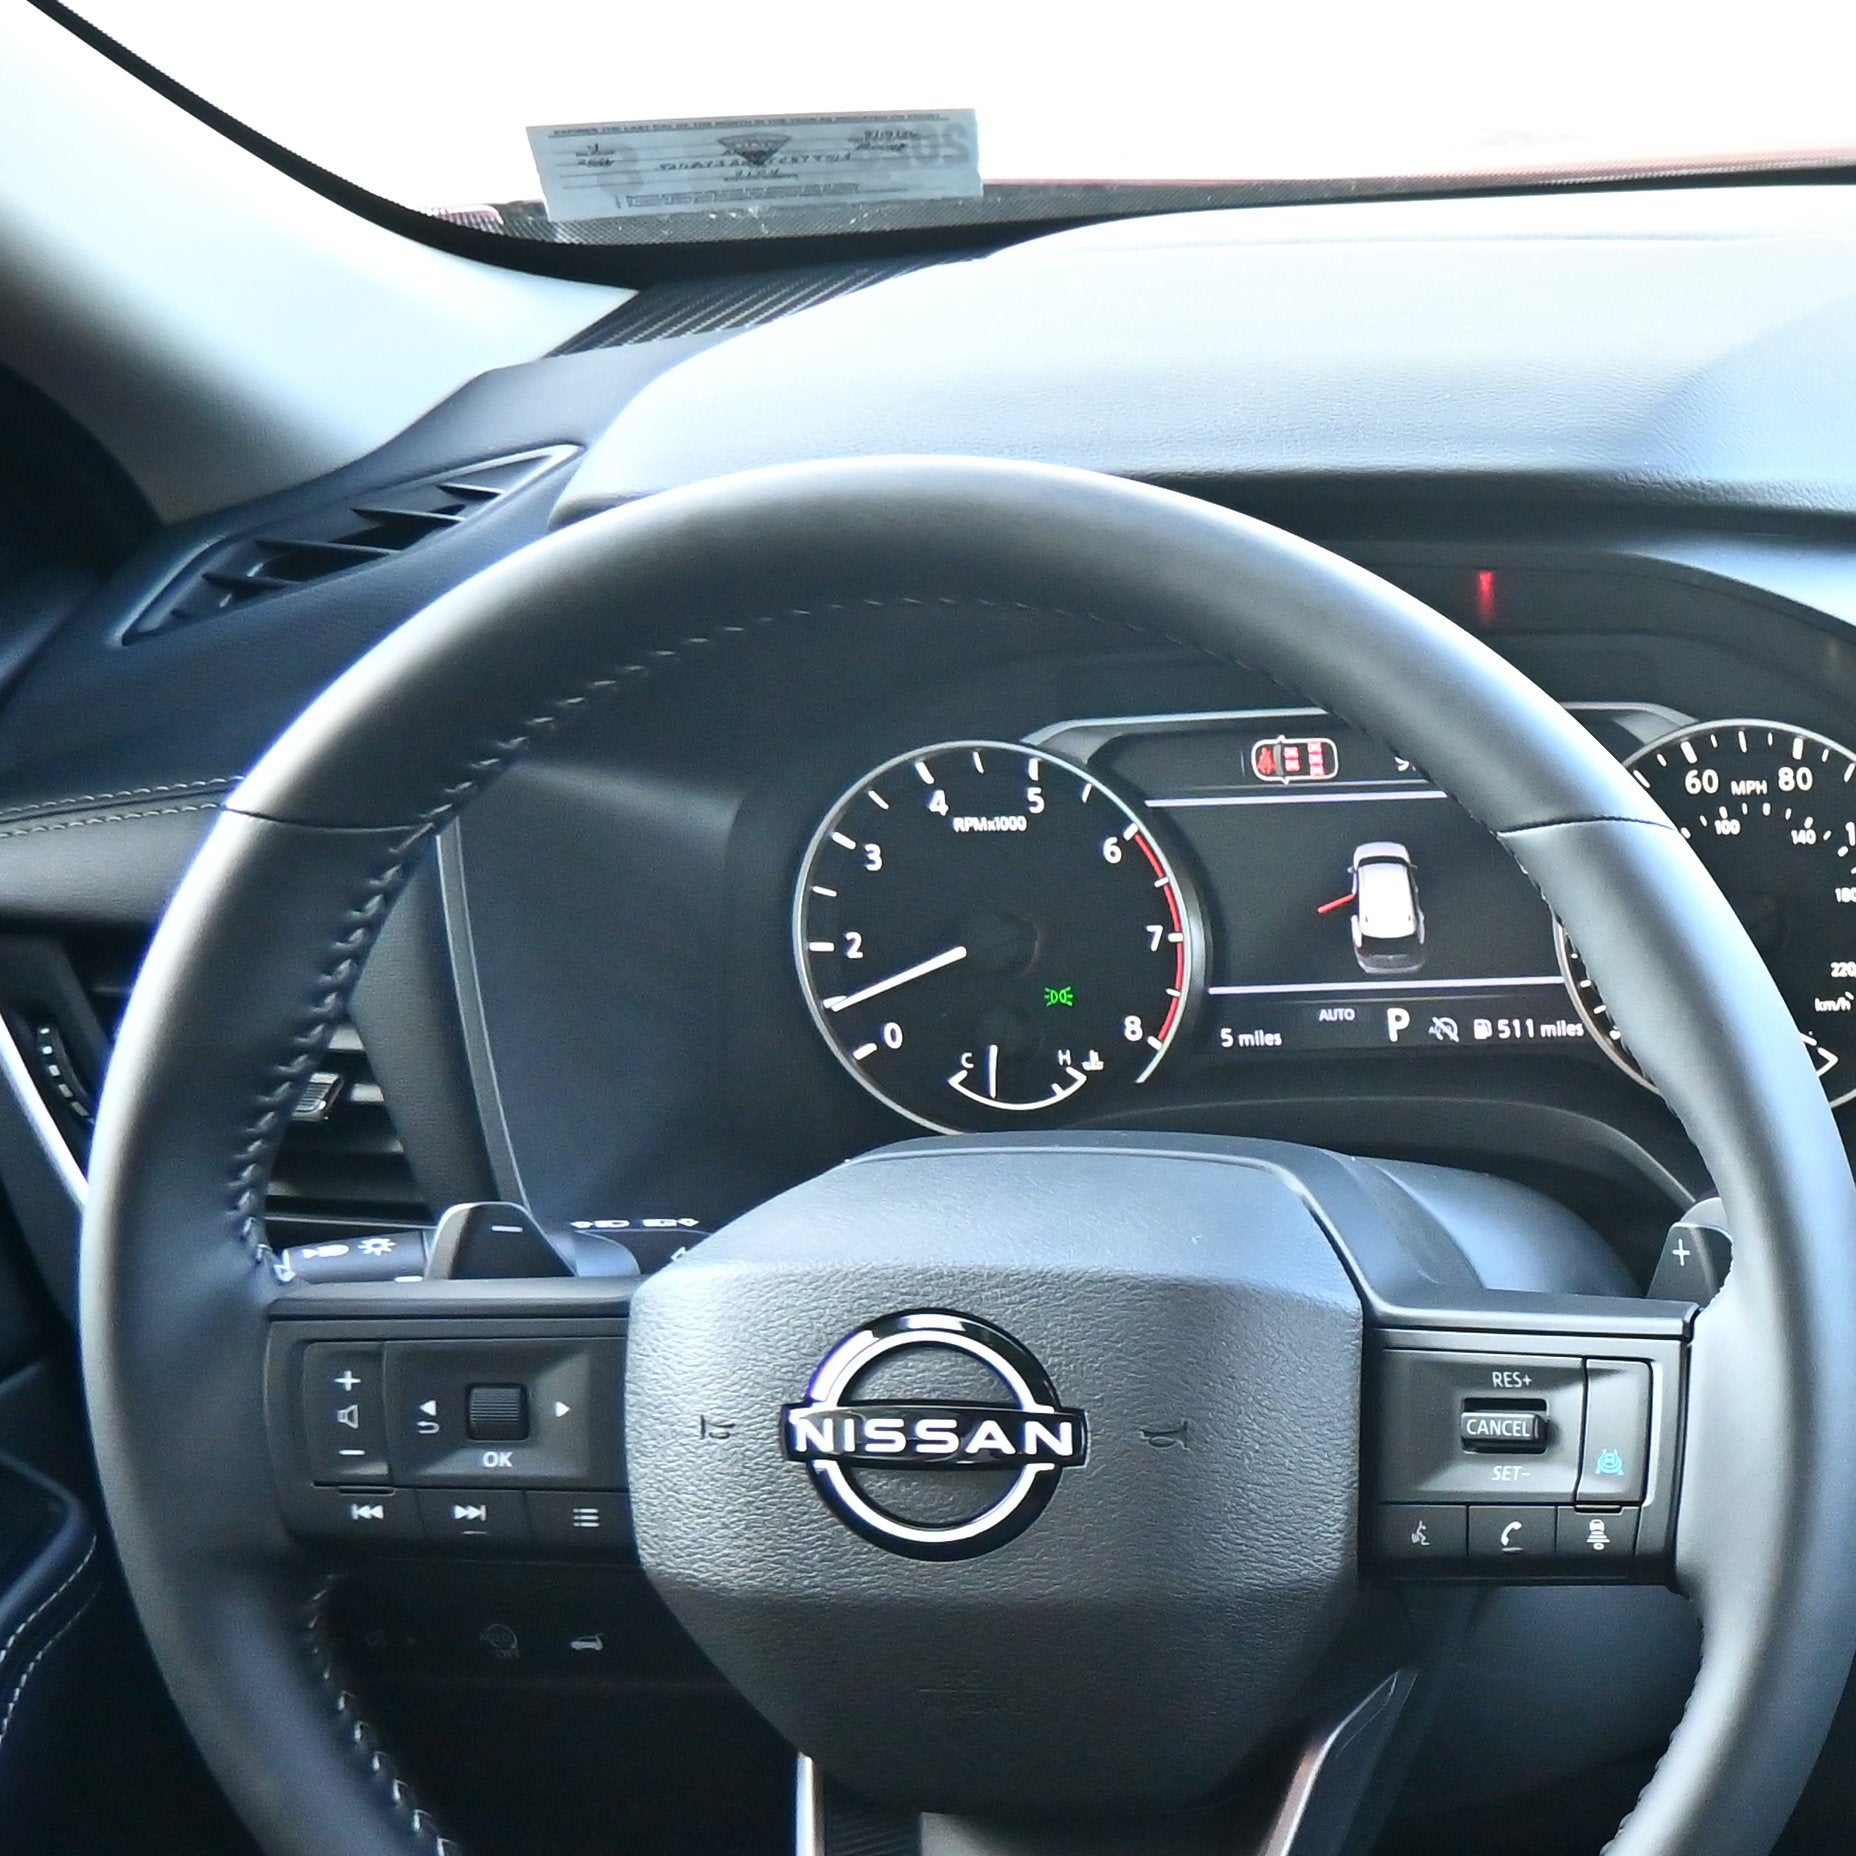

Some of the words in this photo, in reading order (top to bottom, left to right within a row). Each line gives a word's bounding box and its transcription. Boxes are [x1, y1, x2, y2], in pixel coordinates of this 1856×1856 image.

[1685, 769, 1719, 794] 60
[1731, 780, 1767, 795] MPH
[1778, 767, 1813, 791] 80
[928, 790, 949, 816] 4
[1027, 788, 1044, 813] 5
[1714, 820, 1740, 835] 100
[1791, 829, 1817, 845] 140
[864, 844, 882, 871] 3
[1103, 837, 1121, 863] 6
[846, 933, 863, 958] 2
[1146, 925, 1163, 951] 7
[1830, 962, 1856, 977] 220
[1319, 1008, 1355, 1022] AUTO
[1814, 998, 1851, 1012] km/h
[884, 1022, 903, 1048] 0
[1124, 1016, 1142, 1041] 8
[1387, 1008, 1410, 1042] P
[1498, 1018, 1534, 1039] 511
[1540, 1020, 1584, 1037] miles
[1220, 1028, 1234, 1048] 5
[1238, 1031, 1282, 1047] miles
[961, 1052, 973, 1068] C
[1058, 1050, 1071, 1065] H
[794, 1418, 1074, 1456] NISSAN
[1466, 1419, 1531, 1437] CANCEL
[483, 1451, 513, 1469] OK
